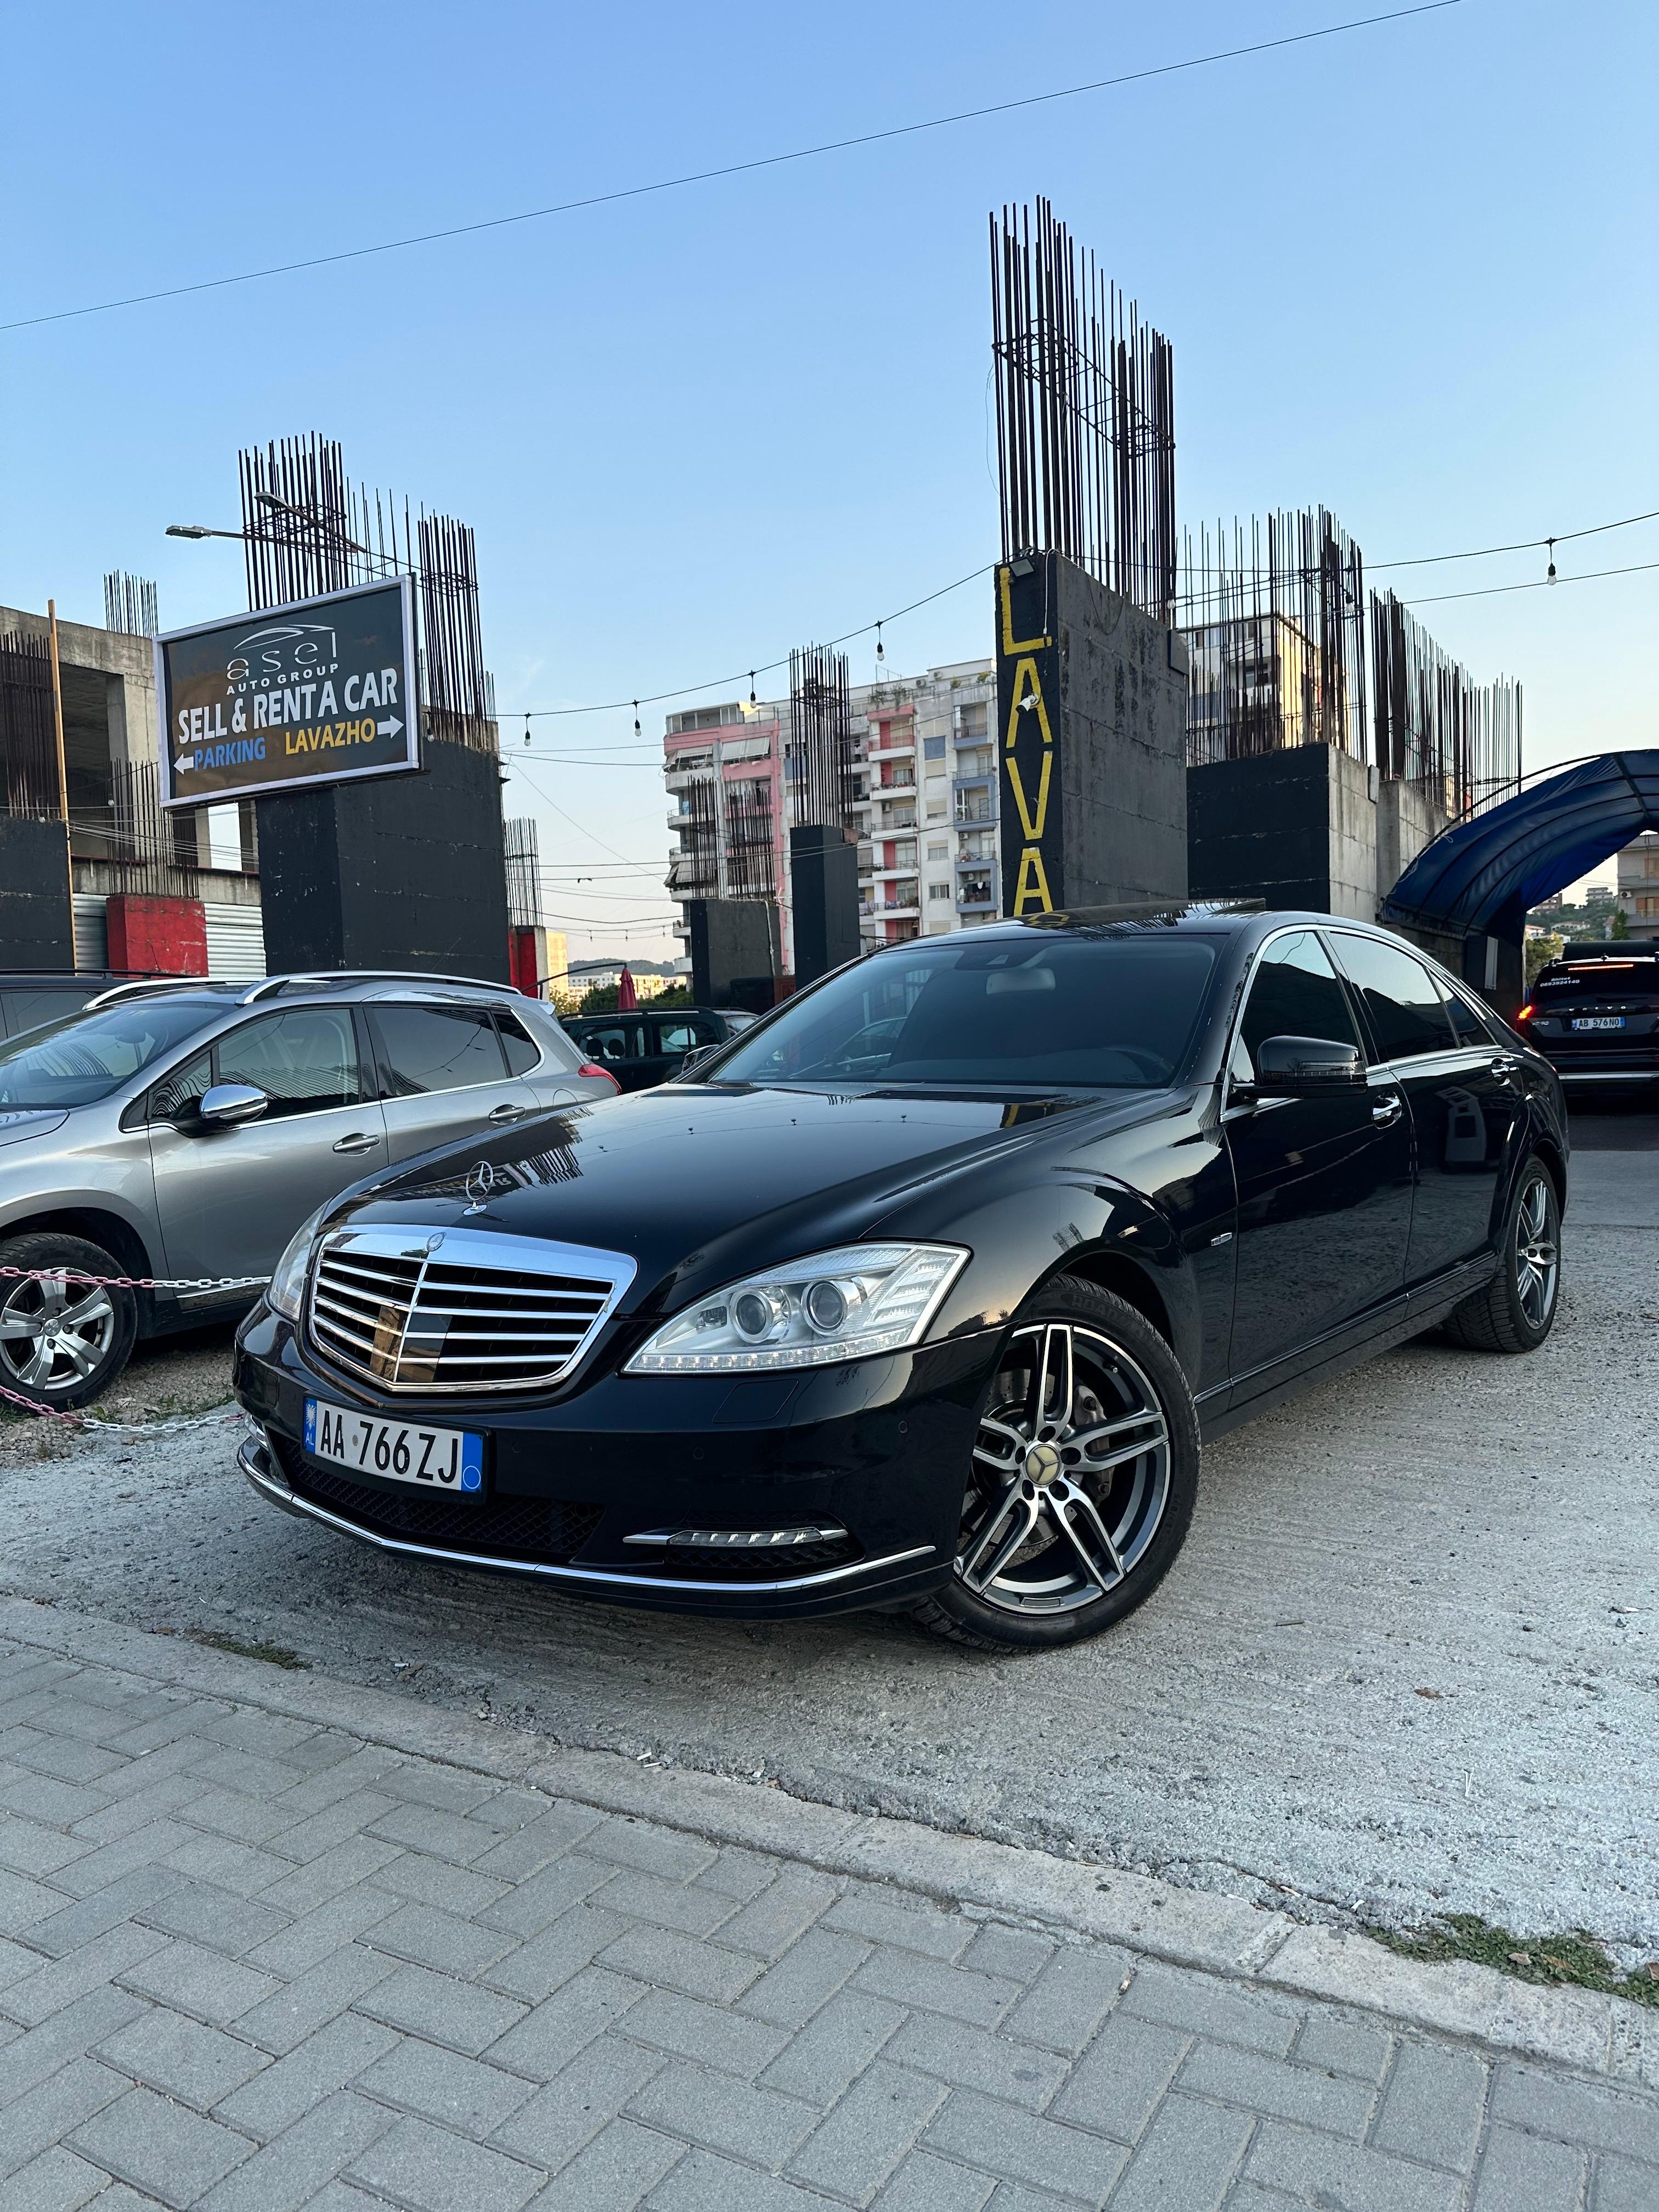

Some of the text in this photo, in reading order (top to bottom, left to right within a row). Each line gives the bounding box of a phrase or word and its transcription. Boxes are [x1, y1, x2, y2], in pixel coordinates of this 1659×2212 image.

[226, 663, 338, 695] AUTO GROUP
[227, 631, 337, 680] asel
[178, 668, 398, 744] SELL & RENT A CAR
[194, 718, 376, 772] PARKING LAVAZHO
[1000, 567, 1053, 916] LAVA
[305, 1432, 314, 1446] AL
[320, 1409, 345, 1459] AA
